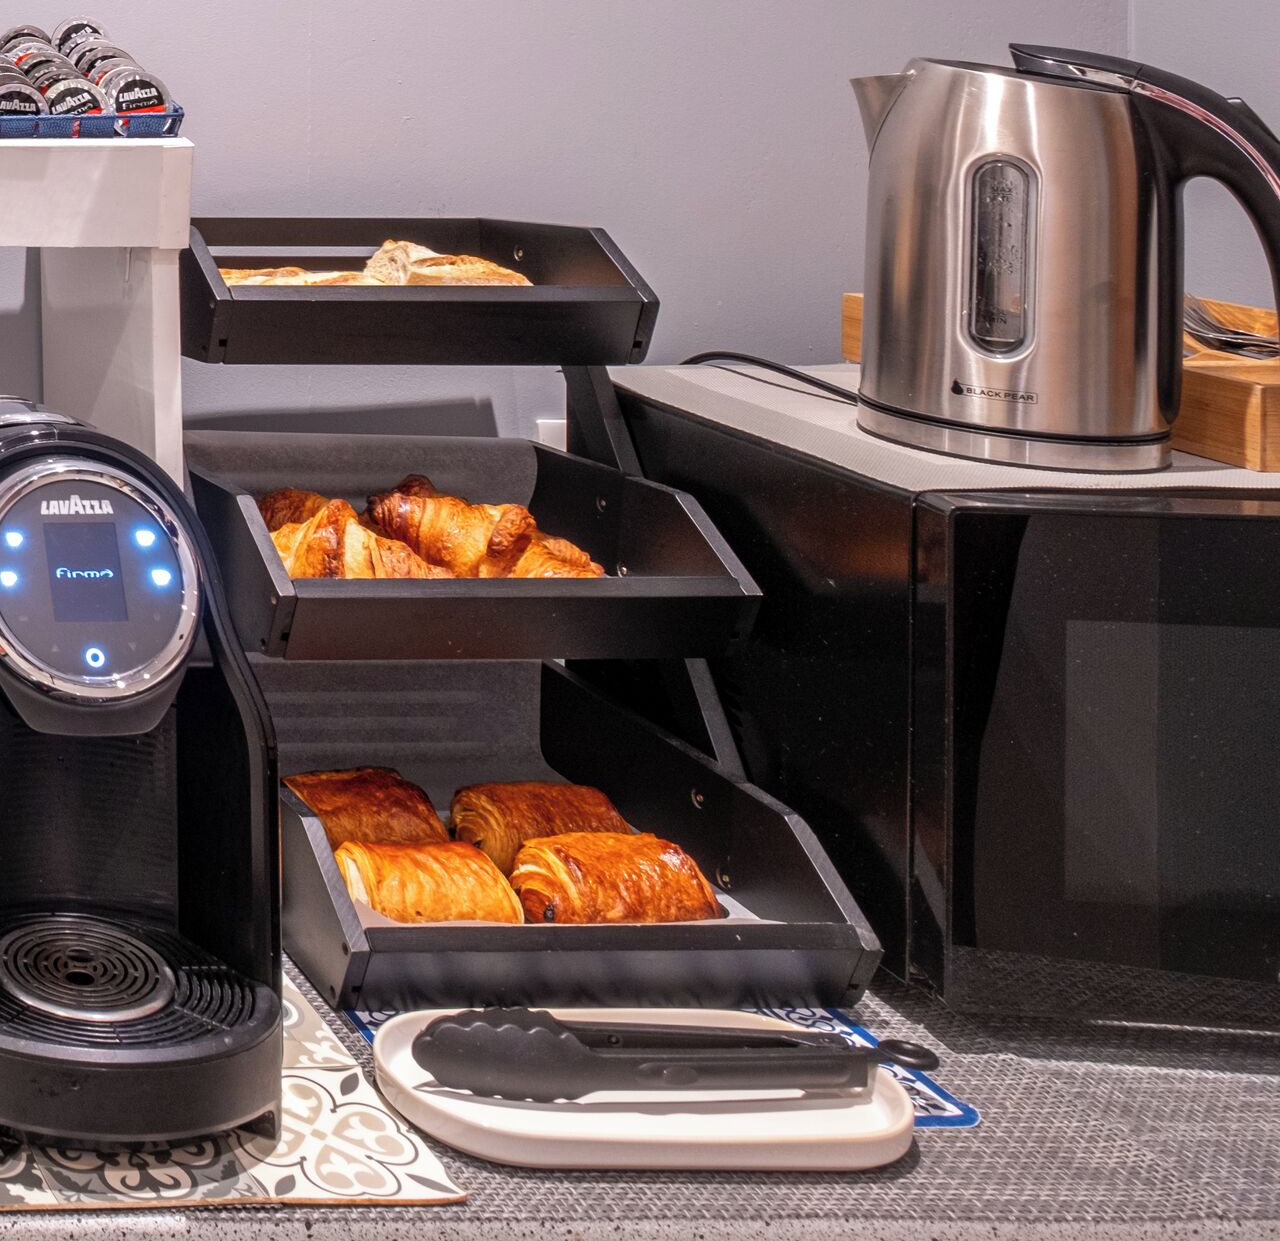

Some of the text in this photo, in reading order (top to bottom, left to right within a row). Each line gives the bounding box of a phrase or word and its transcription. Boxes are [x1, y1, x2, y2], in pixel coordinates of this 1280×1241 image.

[51, 92, 92, 115] LAVAZZA
[119, 87, 158, 102] LAVAZZA
[965, 386, 1035, 402] BLACK PEAR
[40, 494, 114, 515] LAVAZZA
